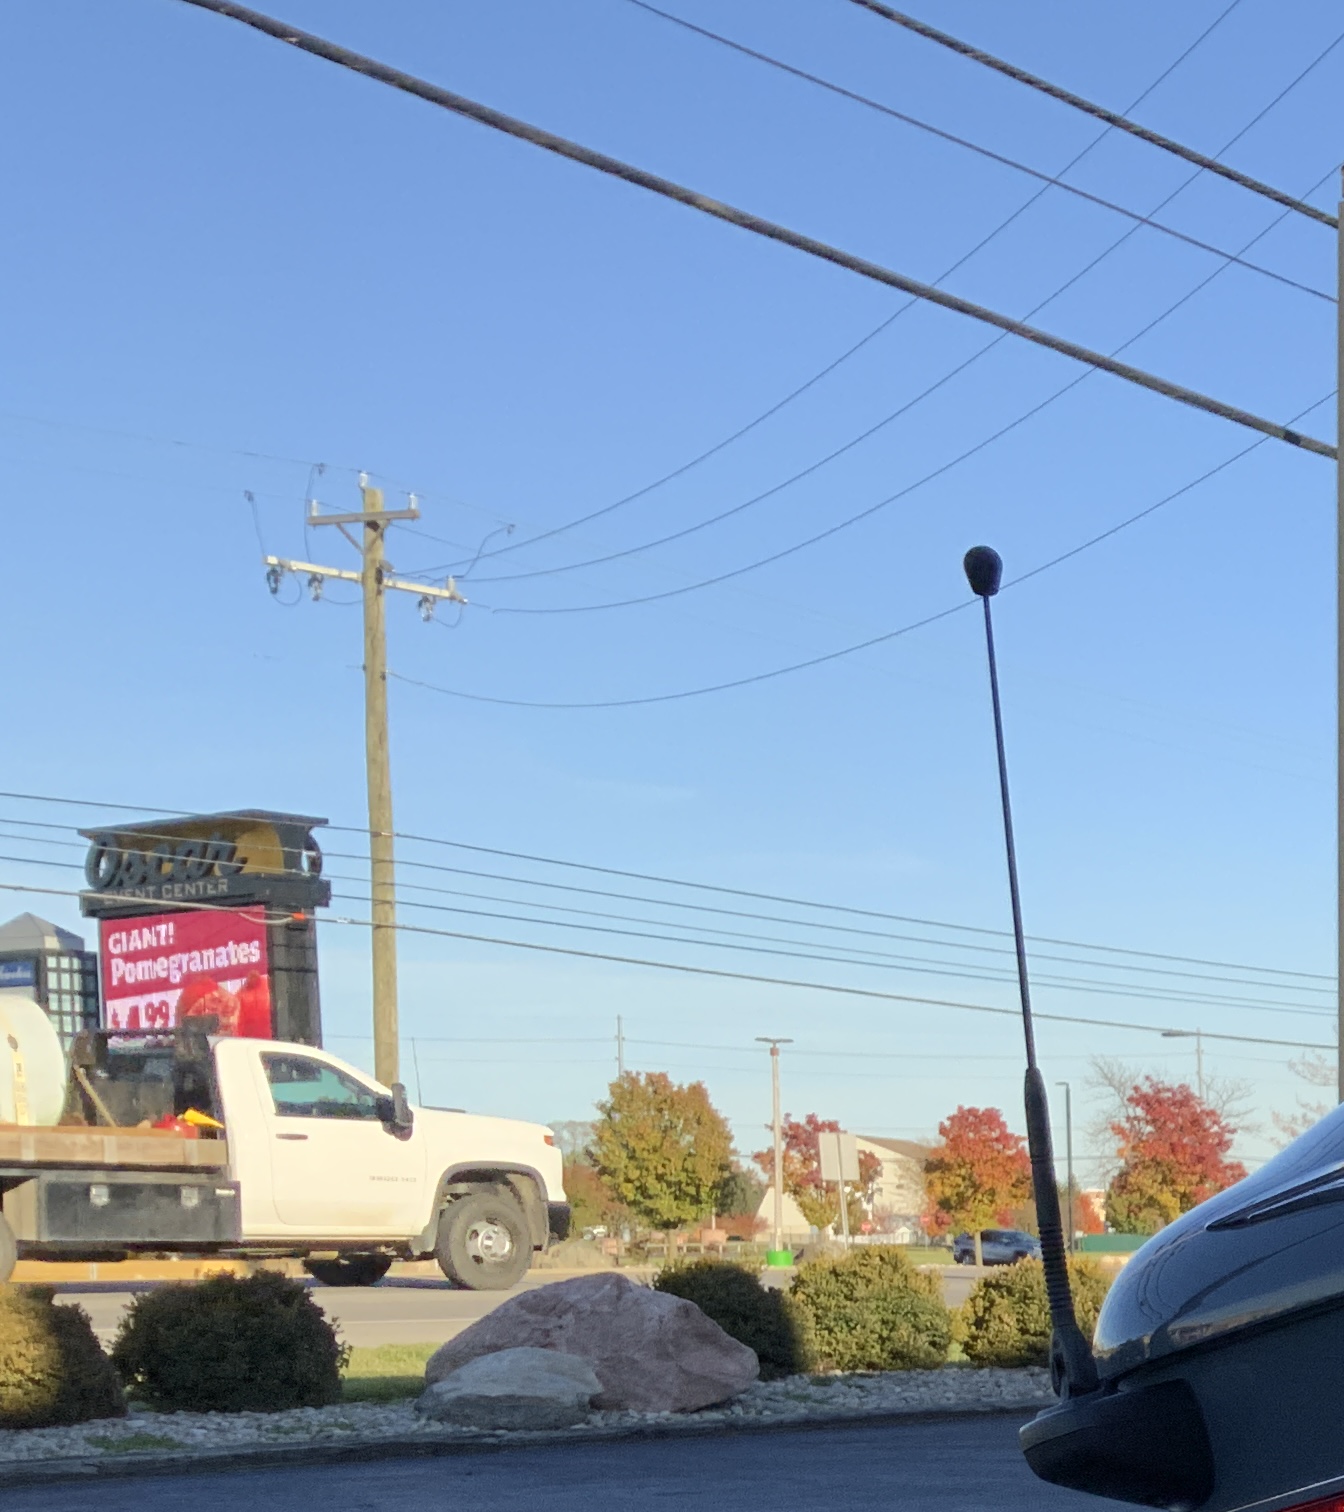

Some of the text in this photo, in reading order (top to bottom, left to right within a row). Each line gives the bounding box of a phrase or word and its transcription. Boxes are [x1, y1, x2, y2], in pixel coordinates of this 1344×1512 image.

[162, 878, 229, 899] CENTER
[108, 922, 175, 955] GIANT!
[110, 939, 261, 986] Pomegranates
